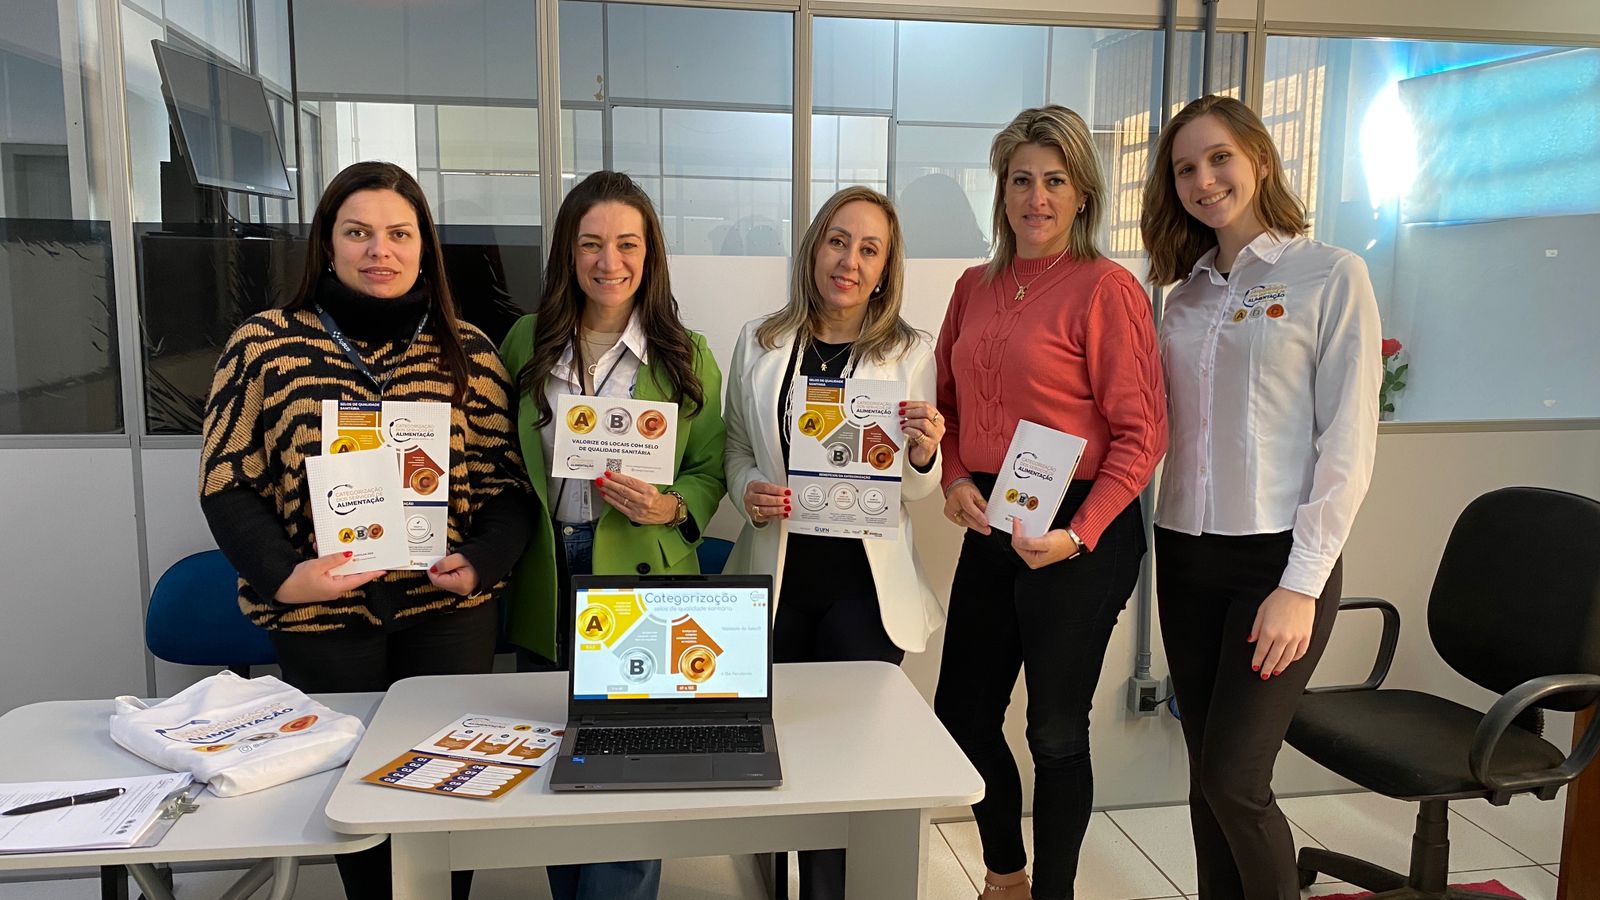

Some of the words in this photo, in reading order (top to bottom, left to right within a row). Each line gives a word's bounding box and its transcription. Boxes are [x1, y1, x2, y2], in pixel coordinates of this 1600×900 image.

[574, 412, 589, 427] A
[610, 414, 624, 429] B
[644, 417, 658, 431] C
[804, 418, 816, 430] A
[572, 438, 599, 446] VALORIZE
[338, 444, 349, 454] A
[587, 446, 621, 454] QUALIDADE
[621, 448, 651, 456] SANITÁRIA
[833, 450, 844, 461] B
[875, 452, 887, 463] C
[1018, 467, 1053, 481] ALIMENTAÇÃO
[419, 476, 431, 489] C
[335, 486, 383, 498] CATEGORIZAÇÃO
[336, 496, 385, 508] ALIMENTAÇÃO
[343, 531, 351, 540] A
[357, 529, 365, 538] B
[371, 527, 379, 535] C
[645, 592, 738, 606] Categorização
[585, 615, 603, 632] A
[629, 659, 645, 675] B
[690, 657, 705, 674] C
[186, 707, 294, 741] ALIMENTAÇÃO
